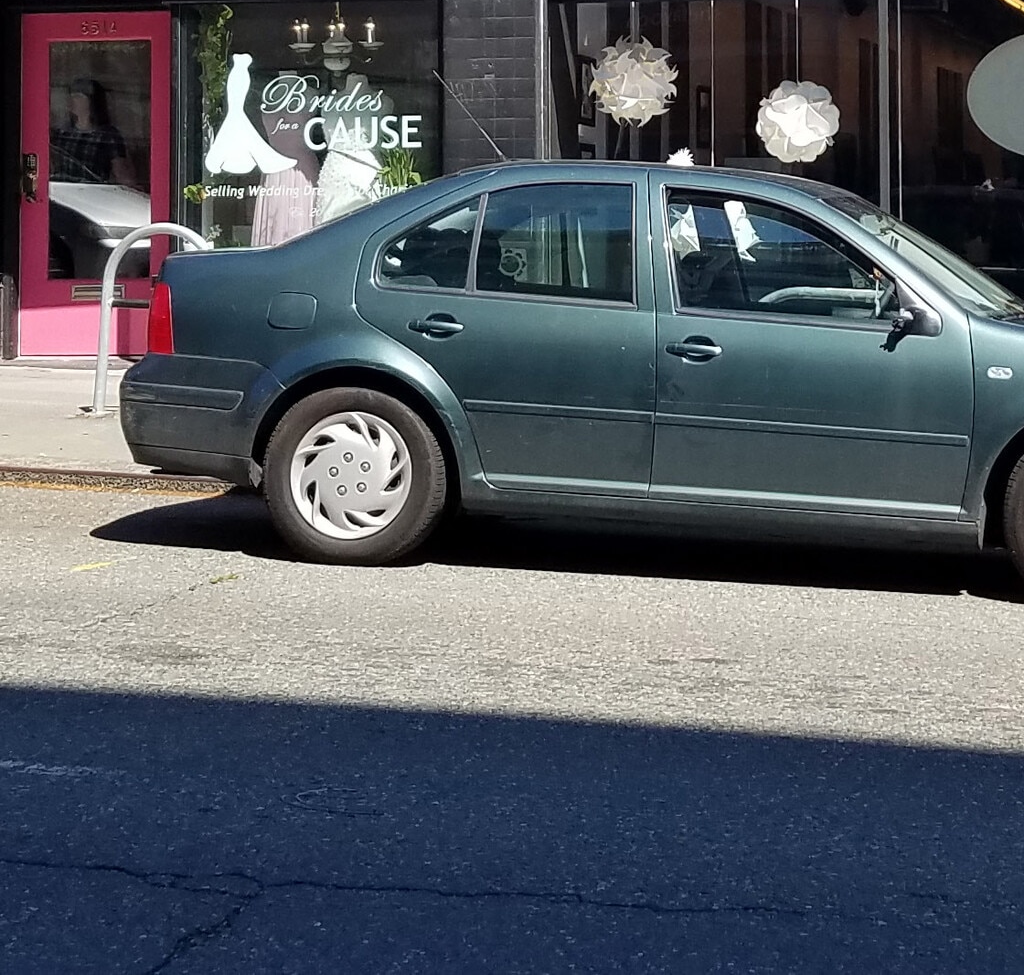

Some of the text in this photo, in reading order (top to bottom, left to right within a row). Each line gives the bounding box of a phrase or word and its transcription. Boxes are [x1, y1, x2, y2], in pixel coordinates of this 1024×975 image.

[260, 75, 383, 114] Brides
[271, 118, 290, 134] for
[304, 115, 422, 151] CAUSE
[205, 186, 245, 199] Selling
[248, 186, 300, 199] Wedding
